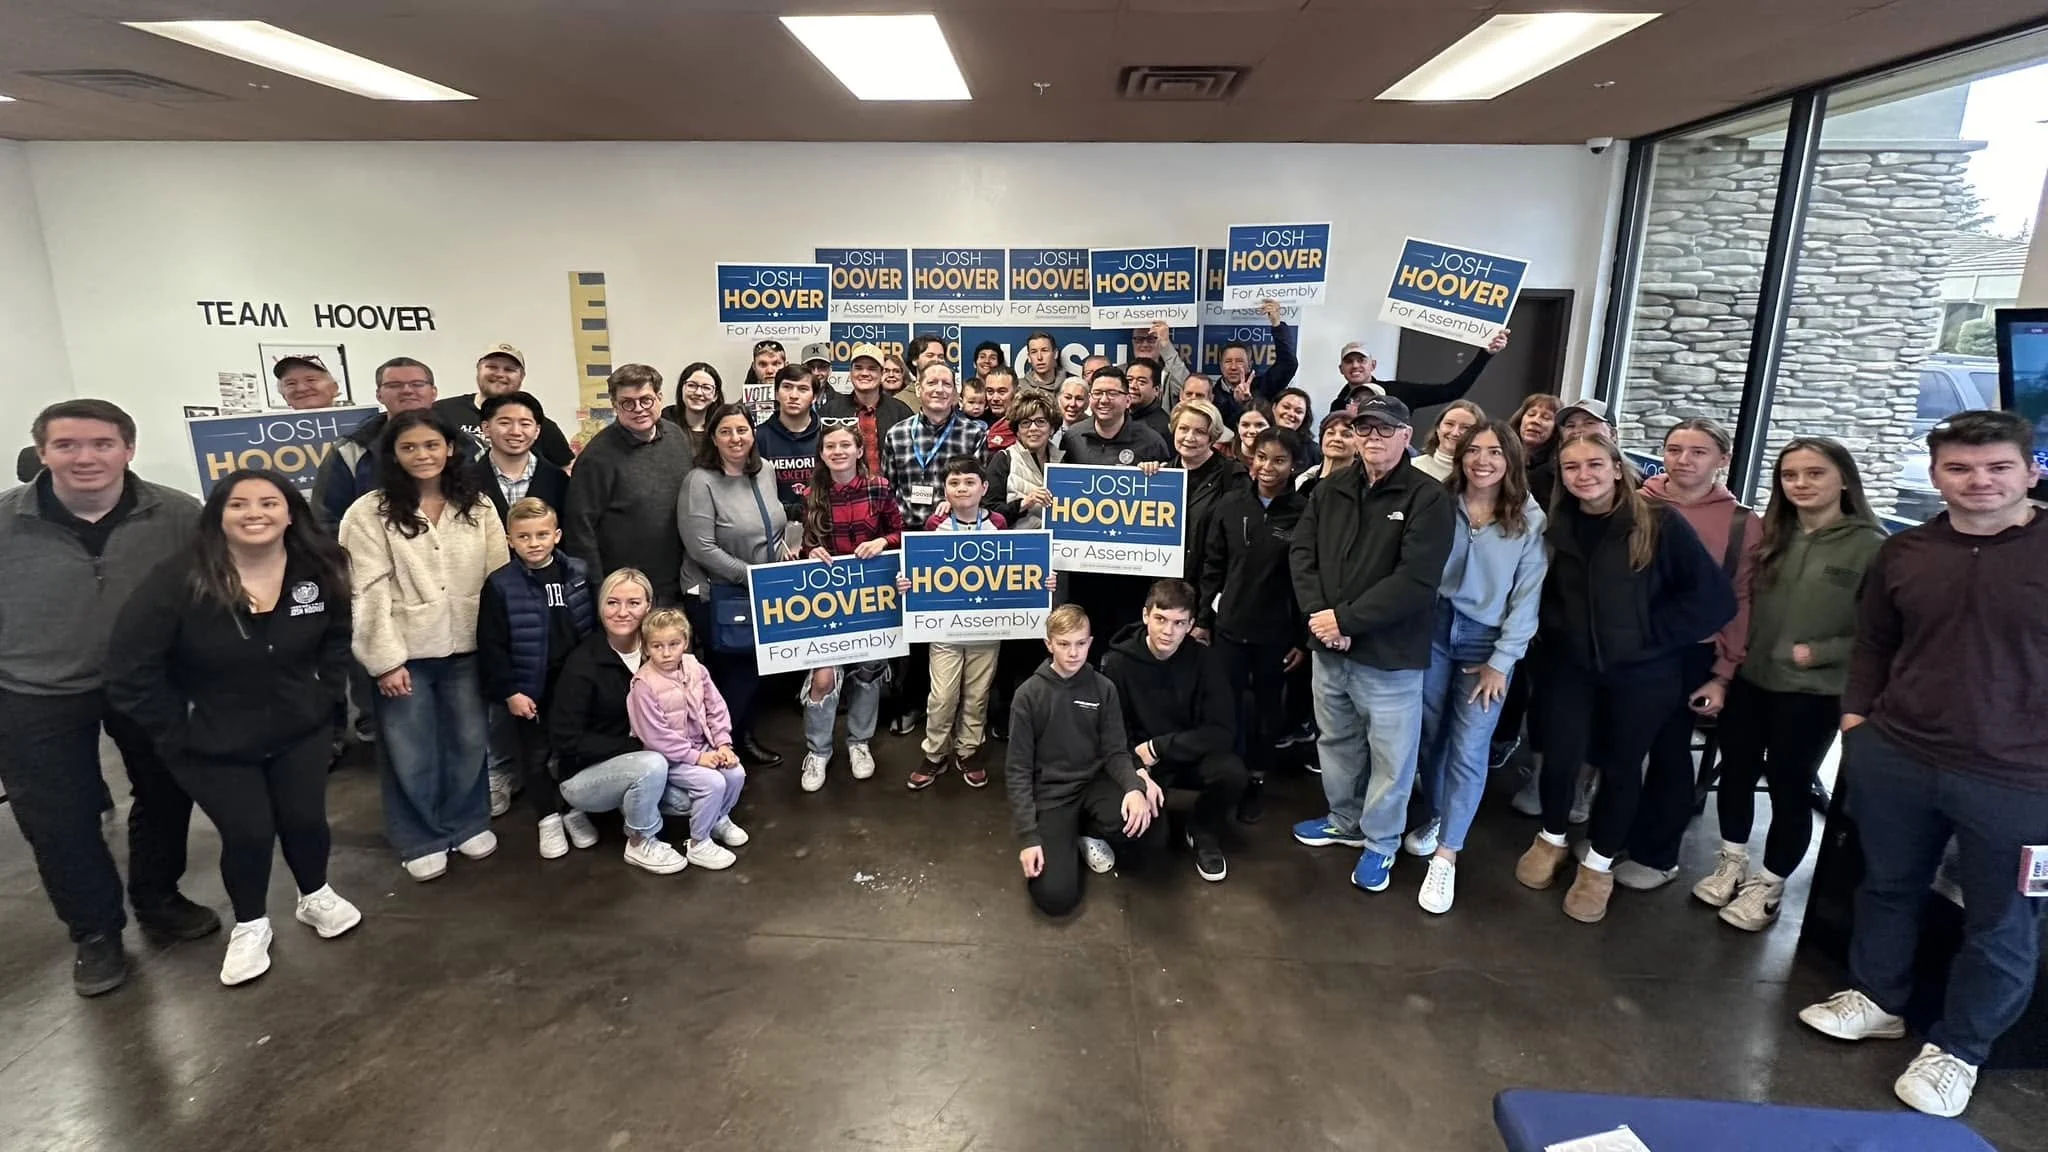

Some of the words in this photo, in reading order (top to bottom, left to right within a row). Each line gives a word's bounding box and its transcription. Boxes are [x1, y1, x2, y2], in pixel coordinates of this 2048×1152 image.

[1255, 229, 1304, 248] JOSH
[839, 251, 884, 266] JOSH
[936, 251, 982, 266] JOSH
[1033, 251, 1079, 266] JOSH
[1118, 252, 1169, 271] JOSH
[1232, 248, 1322, 272] HOOVER
[1431, 251, 1493, 278] JOSH
[748, 270, 802, 287] JOSH
[832, 267, 903, 290] OOVER
[915, 267, 1000, 290] HOOVER
[1096, 270, 1190, 293] HOOVER
[1398, 264, 1510, 308] HOOVER
[724, 288, 824, 309] HOOVER
[1231, 288, 1253, 300] For
[1256, 285, 1318, 298] Assembly
[197, 301, 288, 327] TEAM
[314, 304, 436, 331] HOOVER
[843, 301, 907, 316] Assembly
[914, 301, 935, 314] For
[938, 301, 1004, 316] Assembly
[1010, 302, 1032, 314] For
[1036, 302, 1090, 314] Assemb
[1098, 308, 1119, 320] For
[1123, 305, 1189, 320] Assembly
[726, 324, 749, 336] For
[754, 324, 822, 336] Assembly
[1389, 302, 1414, 318] For
[1416, 308, 1494, 339] Assembly
[842, 325, 886, 339] JOSH
[941, 325, 959, 340] JO
[1227, 327, 1273, 342] JOSH
[744, 385, 772, 402] VOTE
[248, 417, 338, 445] JOSH
[206, 442, 333, 481] HOOV
[1082, 474, 1148, 496] JOSH
[1051, 496, 1176, 527] HOOVER
[943, 540, 1013, 562] JOSH
[1052, 543, 1079, 558] For
[1084, 544, 1172, 567] Assembly
[793, 564, 865, 591] JOSH
[912, 564, 1043, 593] HOOVER
[762, 585, 897, 625] HOOVER
[914, 614, 945, 629] For
[950, 612, 1040, 629] Assembly
[769, 646, 800, 661] For
[806, 632, 897, 656] Assembly
